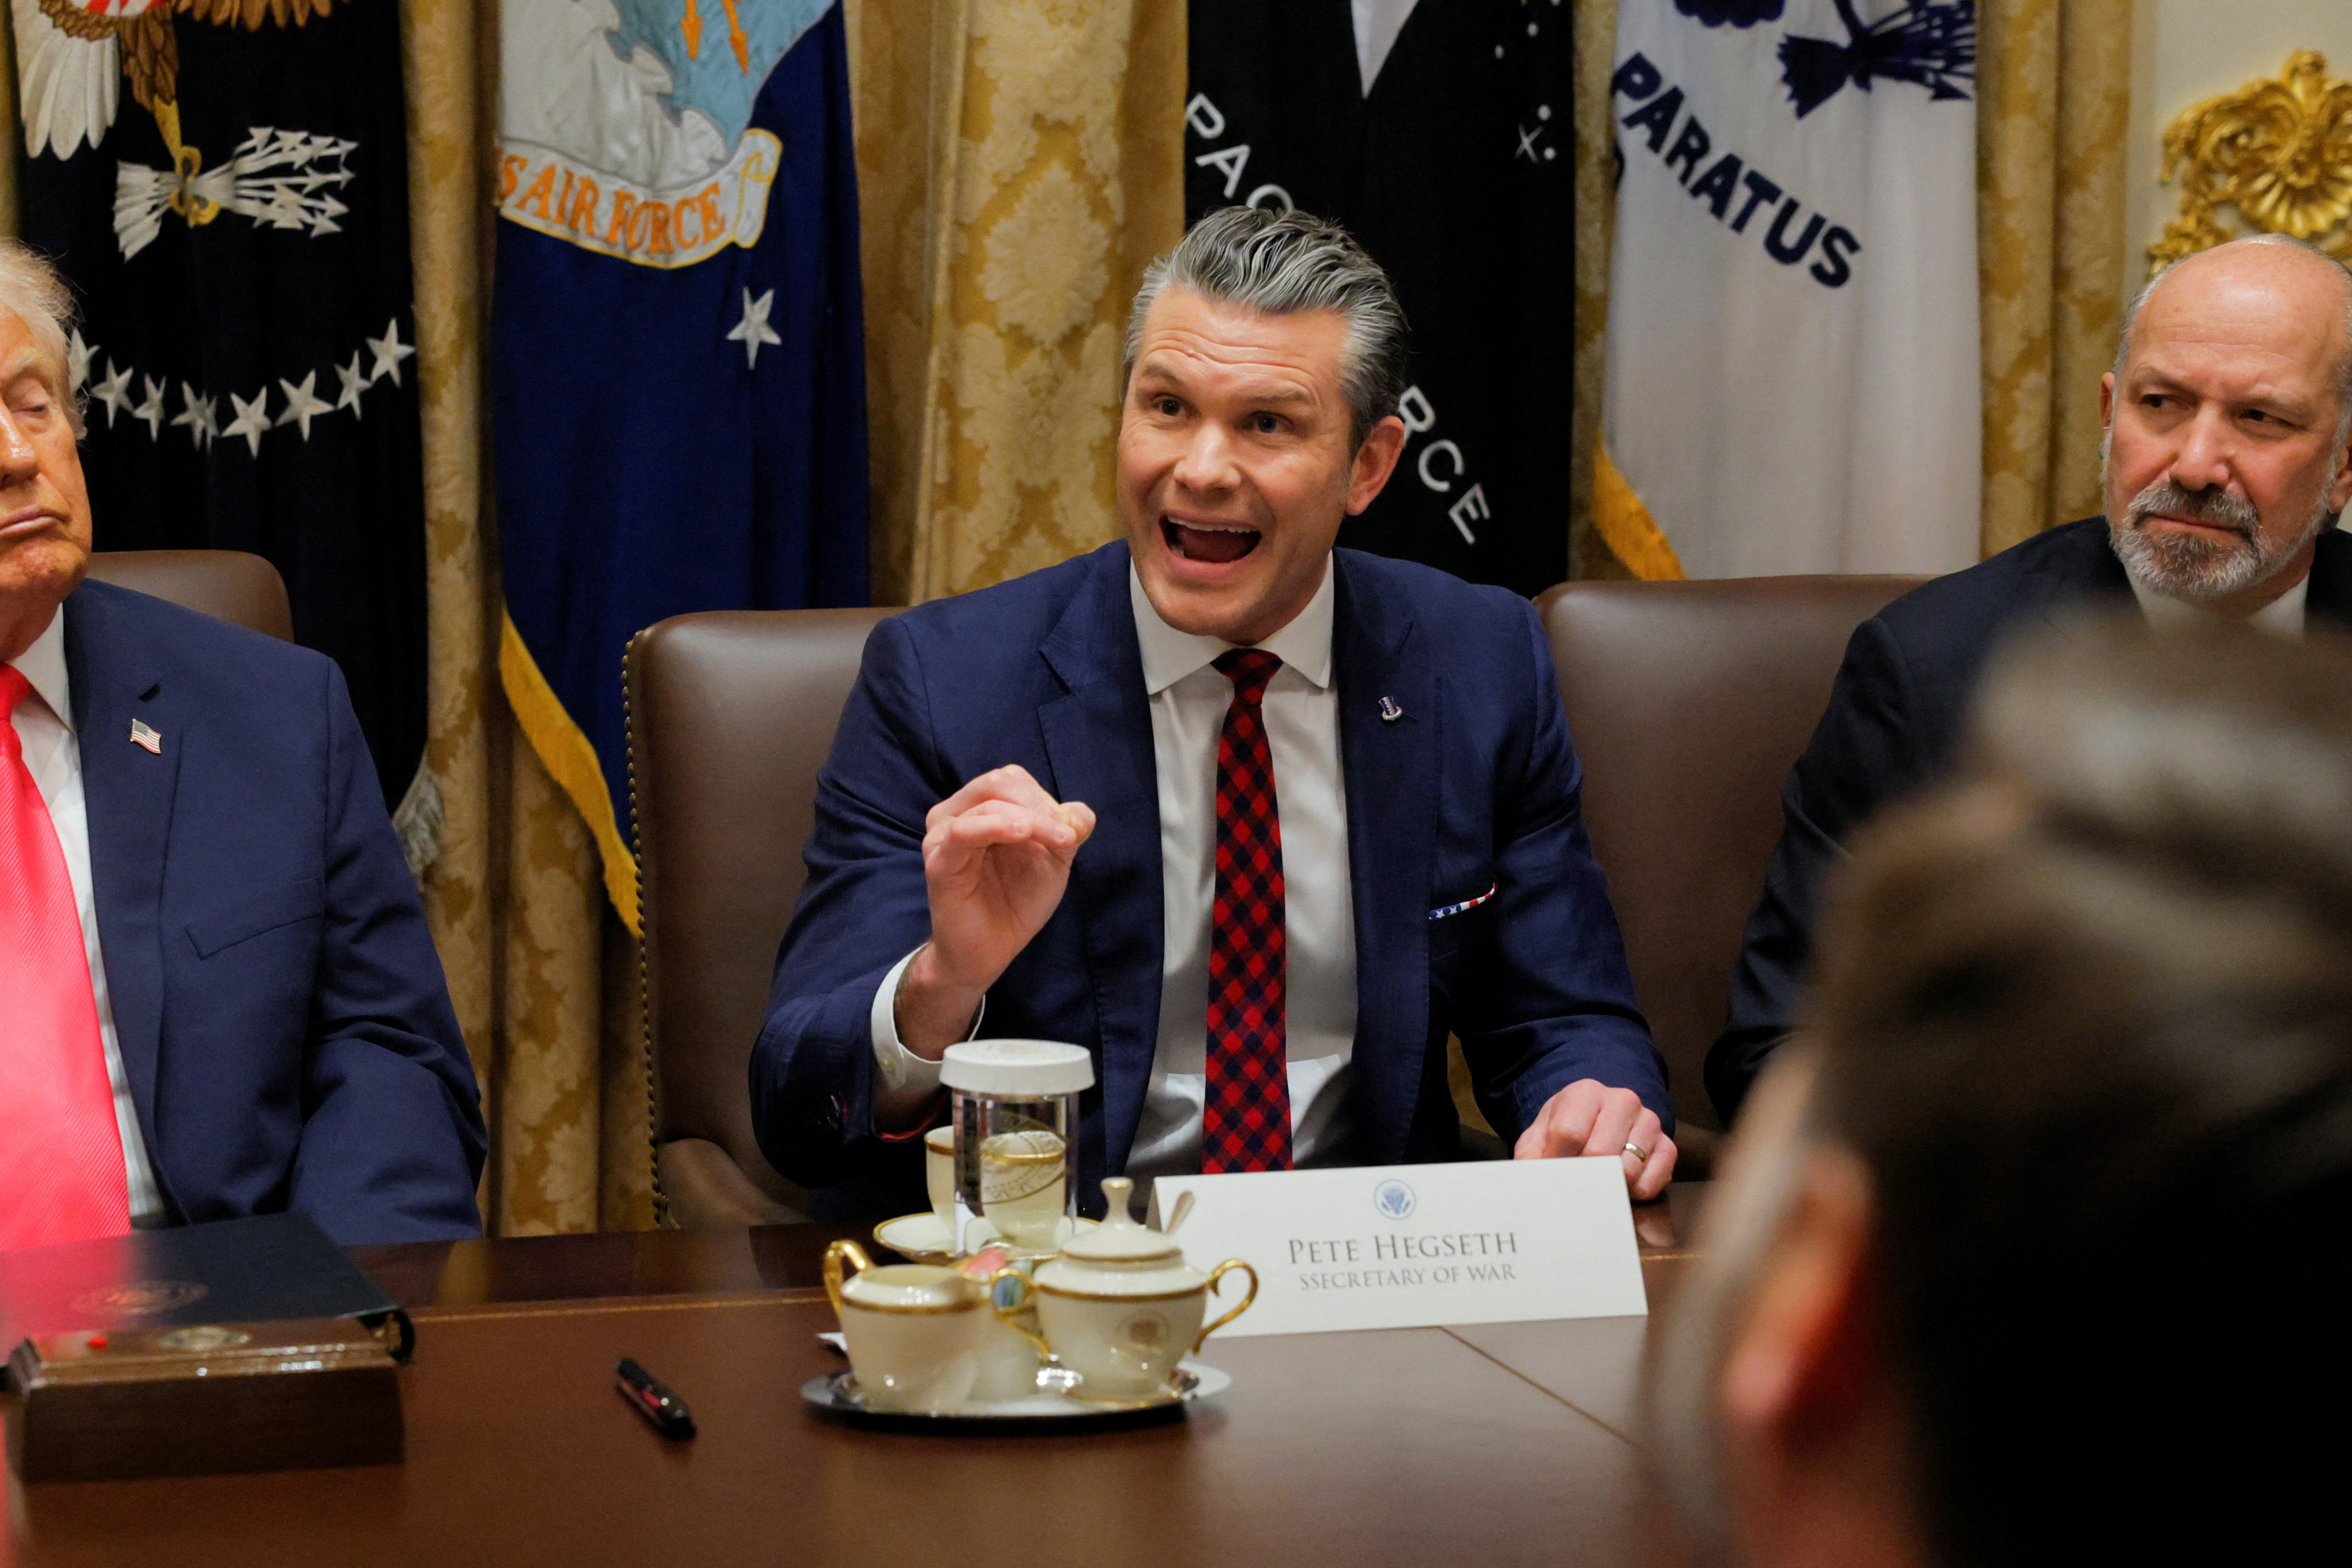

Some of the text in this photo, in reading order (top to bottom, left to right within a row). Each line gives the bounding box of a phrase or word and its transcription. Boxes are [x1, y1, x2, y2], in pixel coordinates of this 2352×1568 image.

[1610, 51, 1862, 289] PARATUS
[514, 164, 600, 238] AIR
[604, 182, 727, 254] FORCE
[1288, 1231, 1518, 1264] PETE HEGSETH
[1433, 1266, 1459, 1284] OF
[1467, 1263, 1516, 1281] WAR
